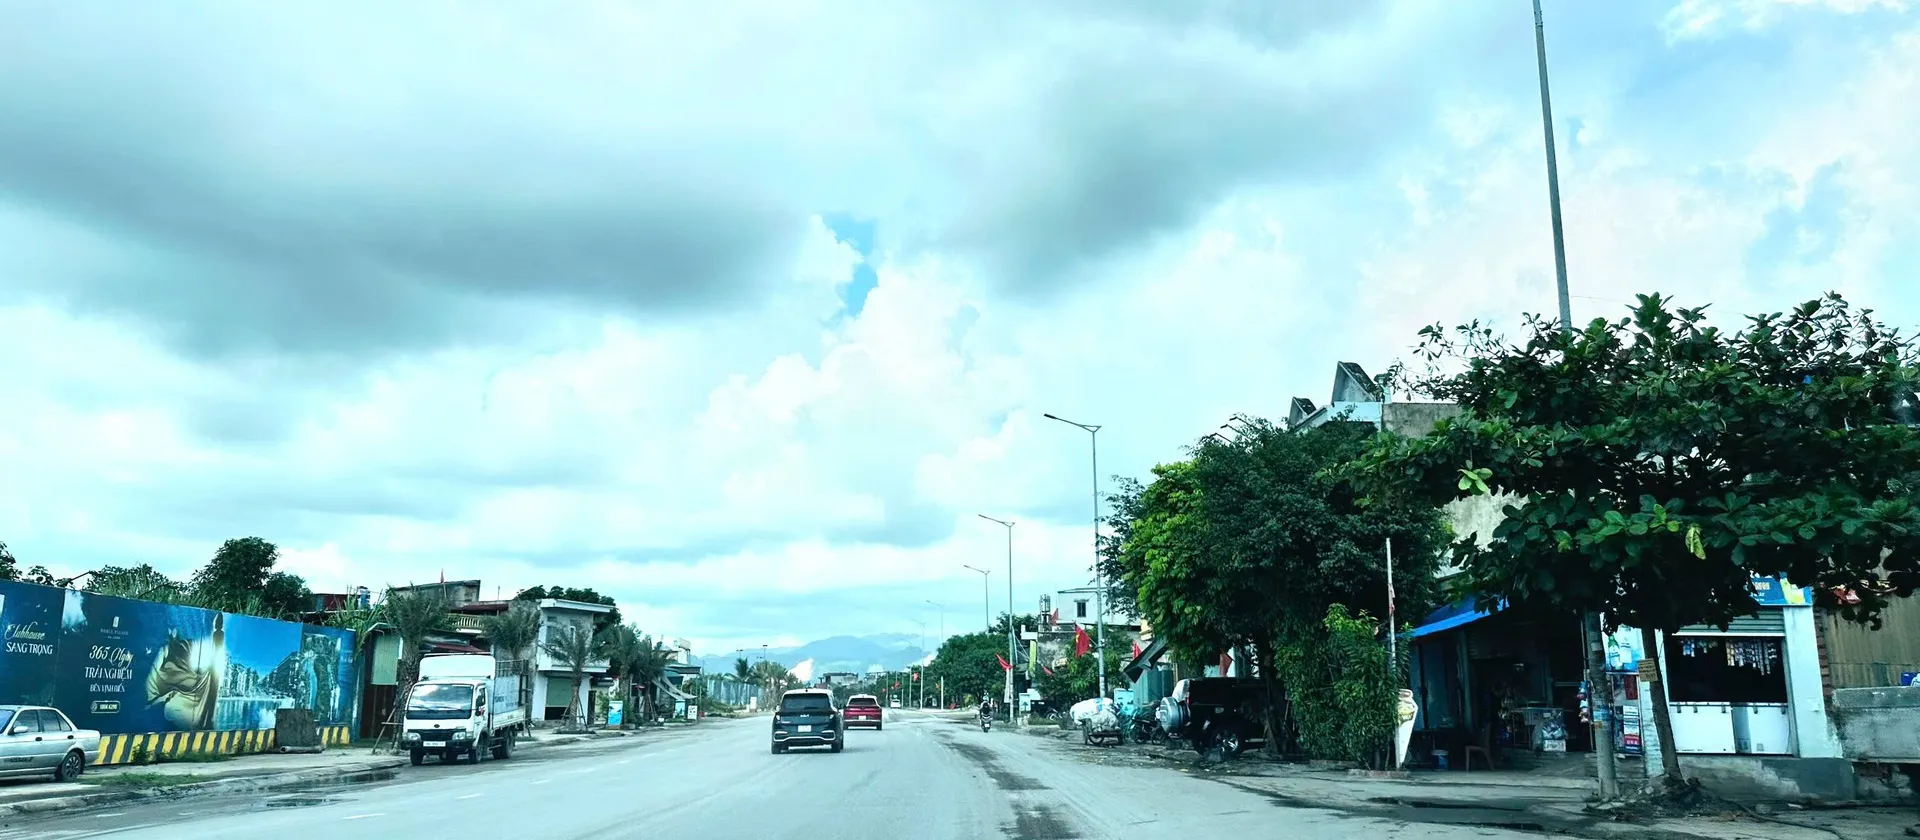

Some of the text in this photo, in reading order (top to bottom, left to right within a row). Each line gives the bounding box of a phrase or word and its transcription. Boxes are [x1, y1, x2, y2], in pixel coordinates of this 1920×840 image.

[4, 621, 45, 640] Clubhouse
[6, 642, 53, 655] SANG TRỌNG
[90, 645, 111, 660] 365
